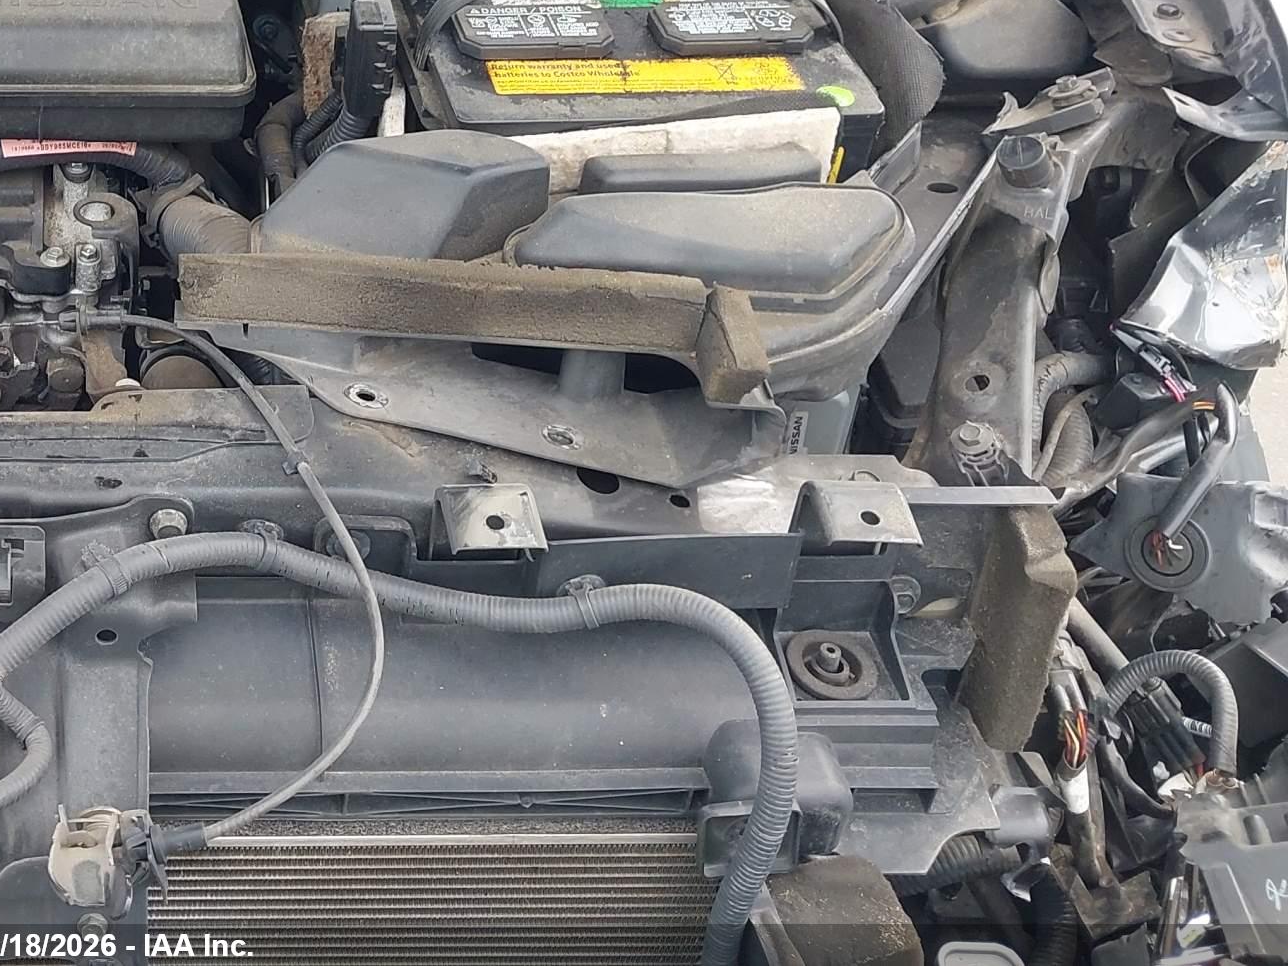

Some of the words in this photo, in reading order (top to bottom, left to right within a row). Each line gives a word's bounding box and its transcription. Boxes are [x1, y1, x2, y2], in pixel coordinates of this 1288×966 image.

[539, 6, 583, 14] POISON
[491, 63, 526, 71] Return
[527, 63, 573, 72] warranty
[575, 62, 594, 70] and
[494, 70, 539, 78] batteries
[553, 70, 586, 78] Costco
